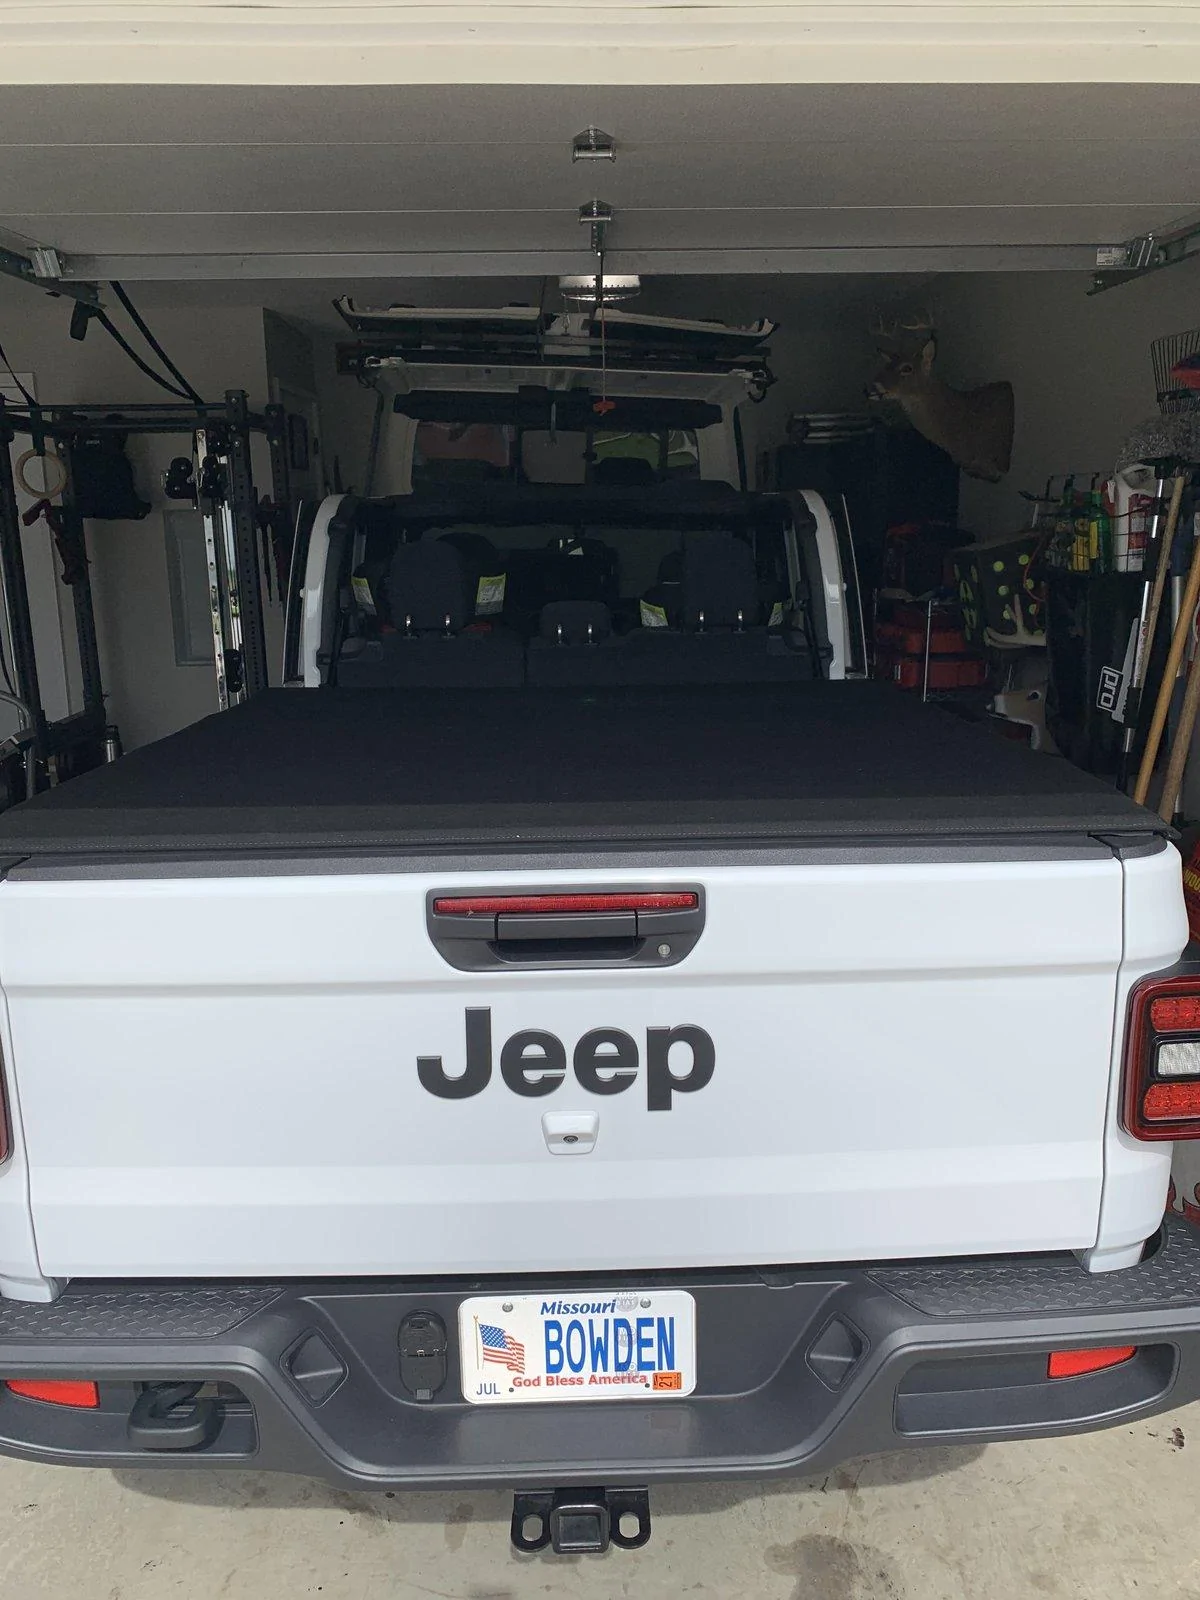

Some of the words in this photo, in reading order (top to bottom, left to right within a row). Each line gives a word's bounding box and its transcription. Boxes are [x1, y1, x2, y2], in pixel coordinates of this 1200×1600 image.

[1101, 669, 1119, 708] pro
[416, 1006, 716, 1111] Jeep
[540, 1299, 616, 1315] Missouri
[544, 1317, 675, 1374] BOWDEN
[512, 1375, 541, 1387] God
[546, 1374, 584, 1386] Bless
[588, 1373, 647, 1386] America
[658, 1376, 673, 1388] 21
[476, 1383, 501, 1395] JUL
